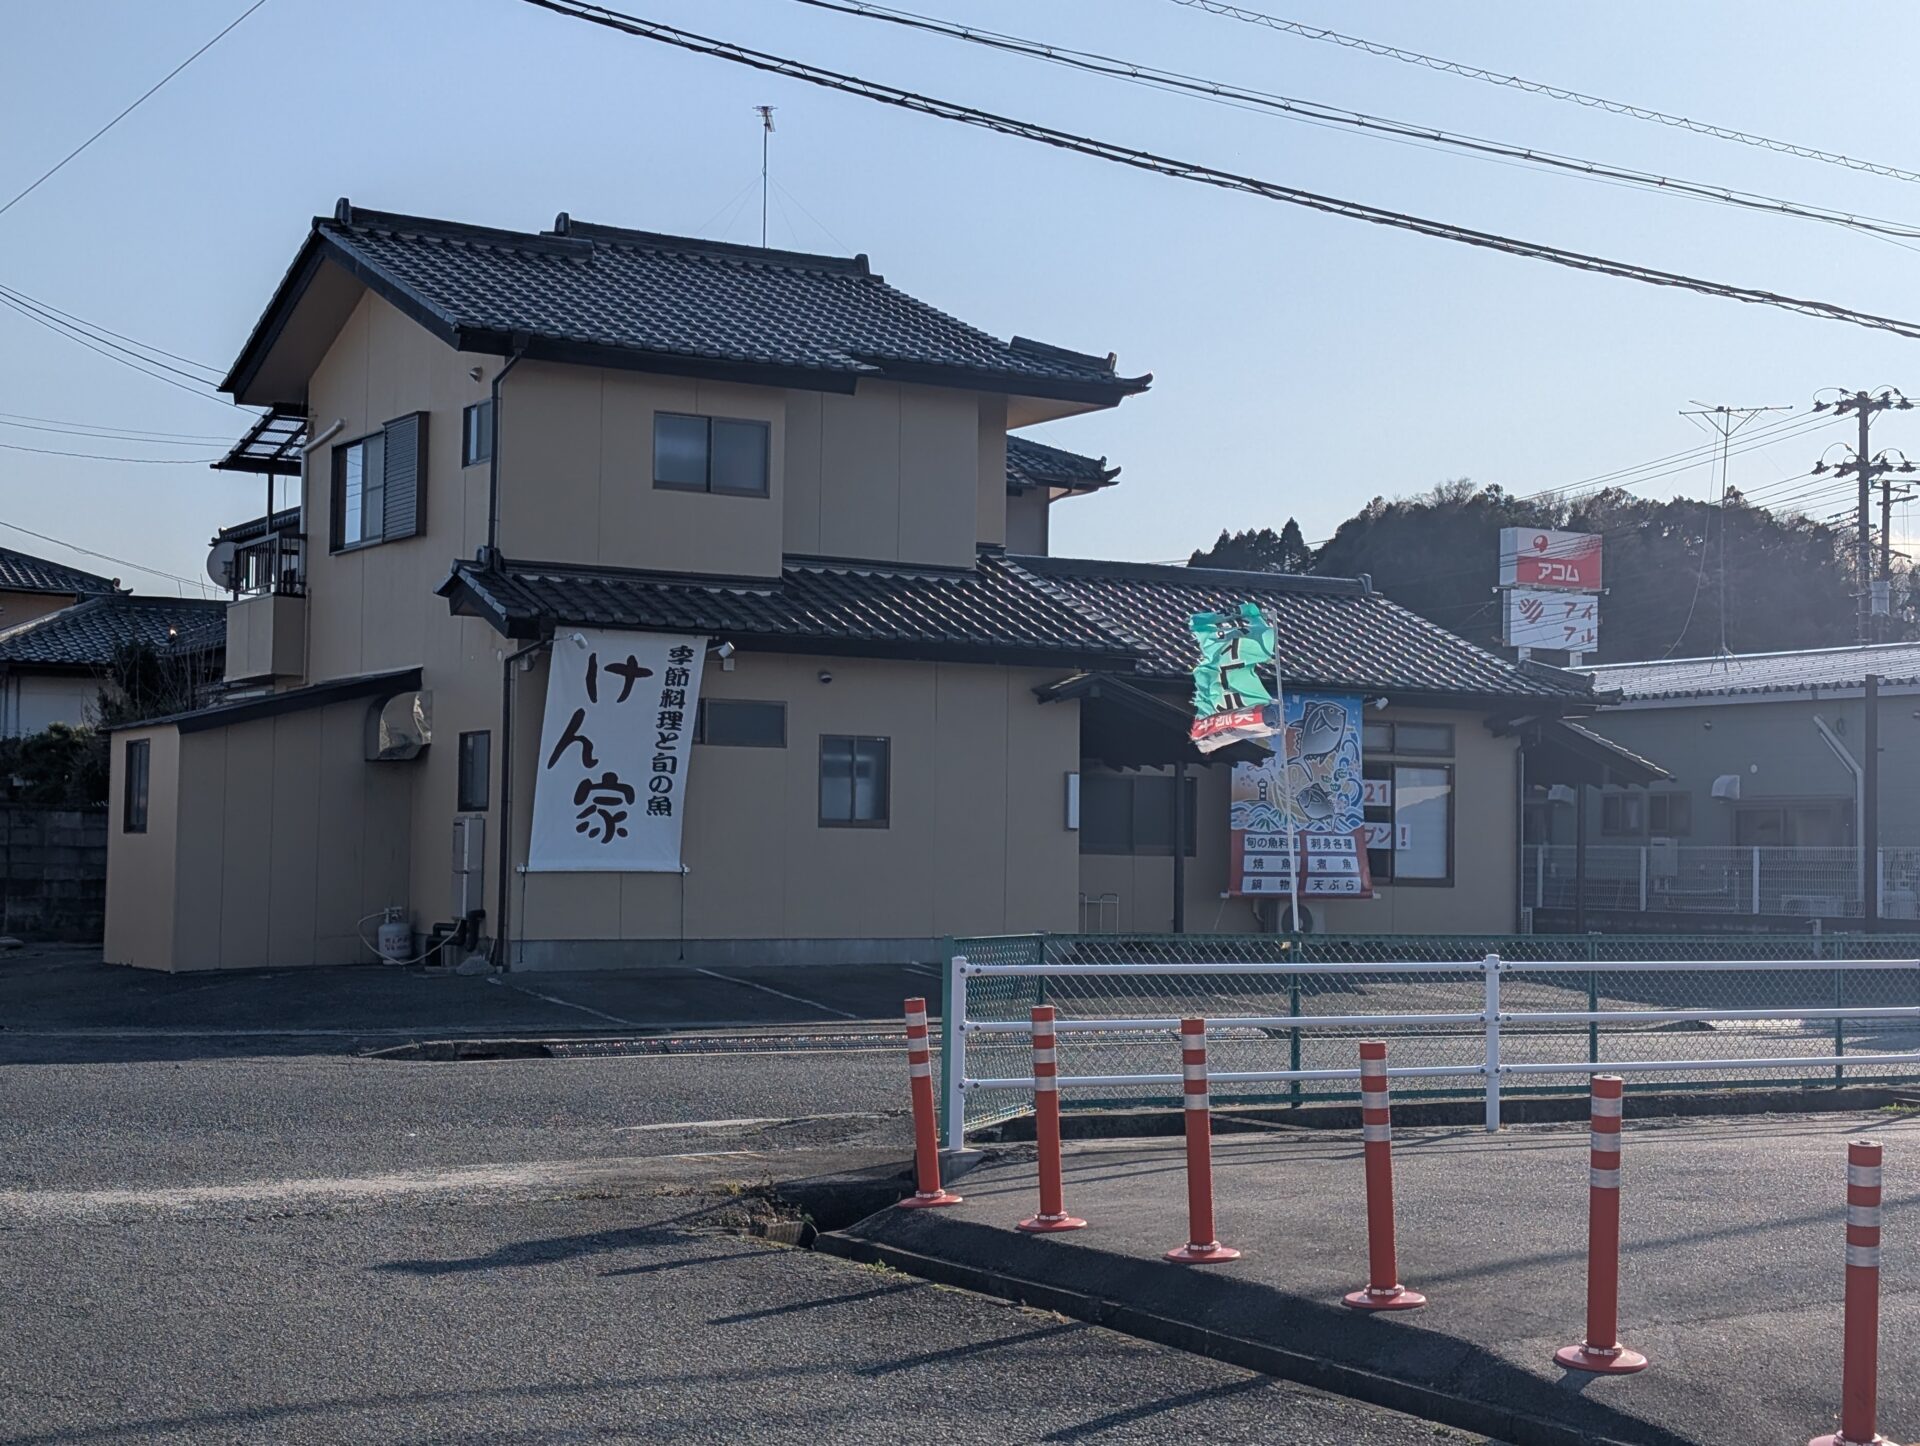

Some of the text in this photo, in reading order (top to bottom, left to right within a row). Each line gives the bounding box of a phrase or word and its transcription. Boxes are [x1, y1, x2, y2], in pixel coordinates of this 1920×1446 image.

[1538, 562, 1579, 582] アコム
[646, 645, 695, 817] 季節料理と旬の魚
[547, 652, 653, 844] けん家
[1310, 838, 1353, 850] 刺身各種
[1316, 858, 1353, 870] 煮魚
